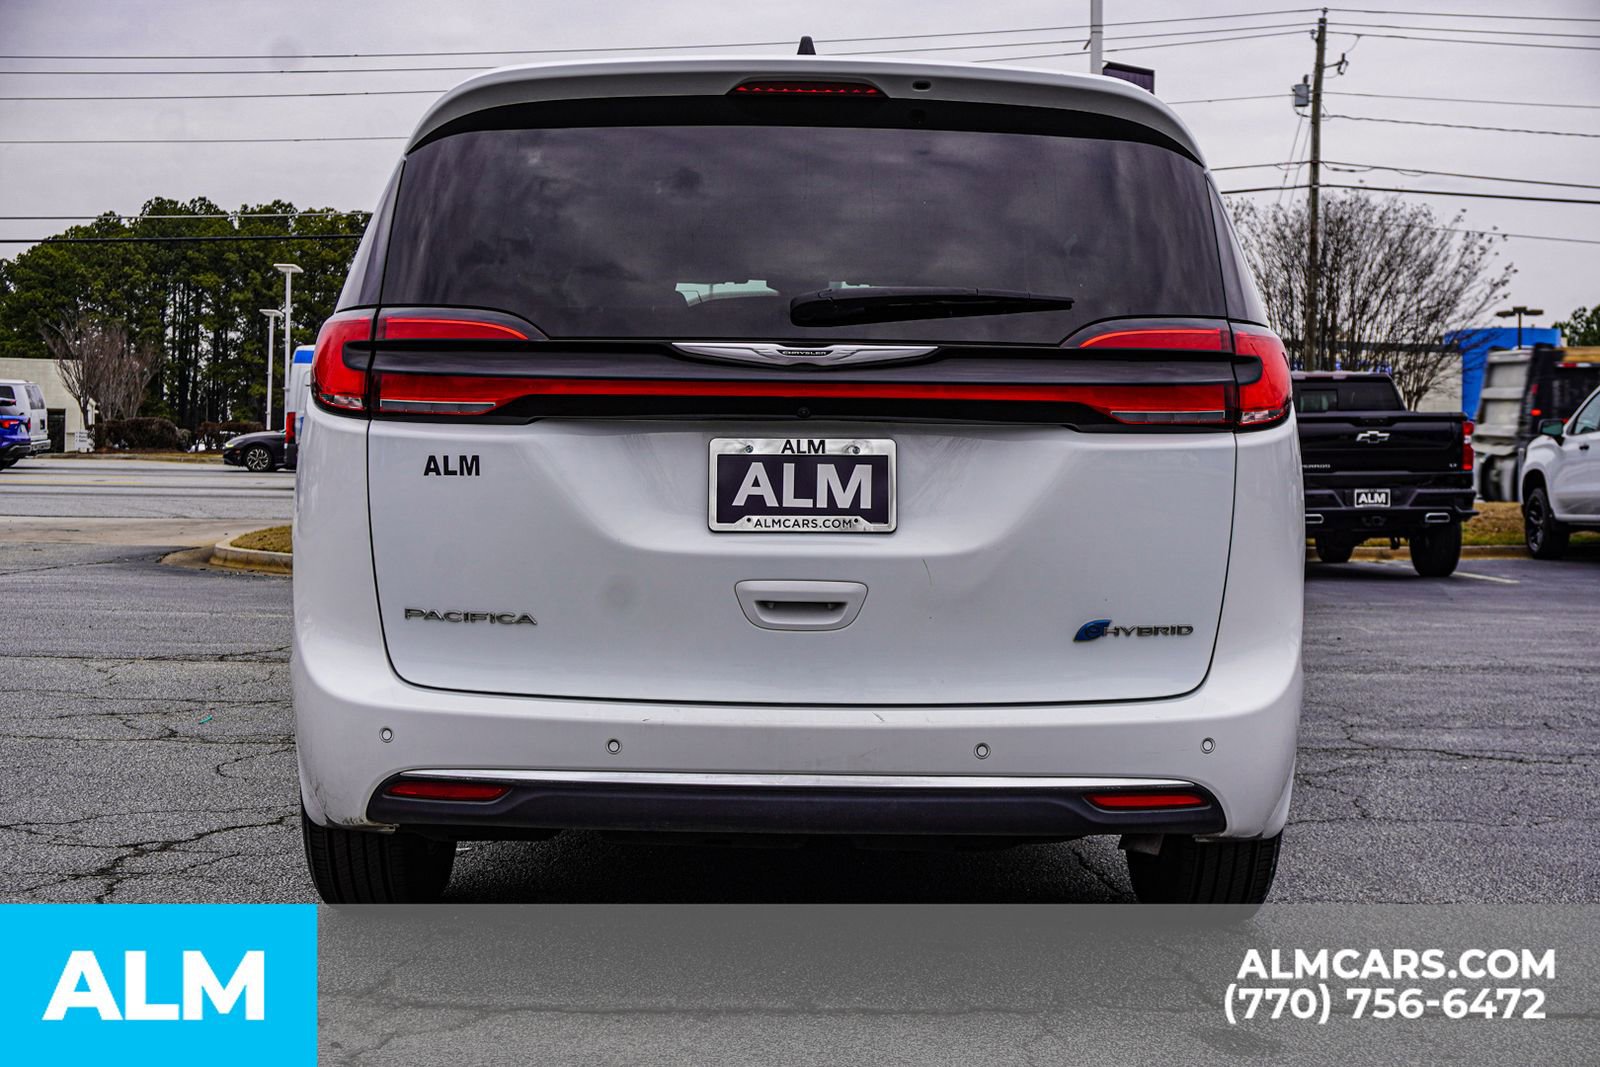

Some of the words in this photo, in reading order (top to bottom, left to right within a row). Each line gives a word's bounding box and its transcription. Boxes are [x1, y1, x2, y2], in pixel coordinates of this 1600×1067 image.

[781, 439, 826, 454] ALM
[423, 455, 480, 476] ALM
[731, 461, 873, 510] ALM
[1358, 493, 1386, 503] ALM
[754, 518, 852, 529] ALMCARS.COM
[404, 608, 538, 626] PACIFICA
